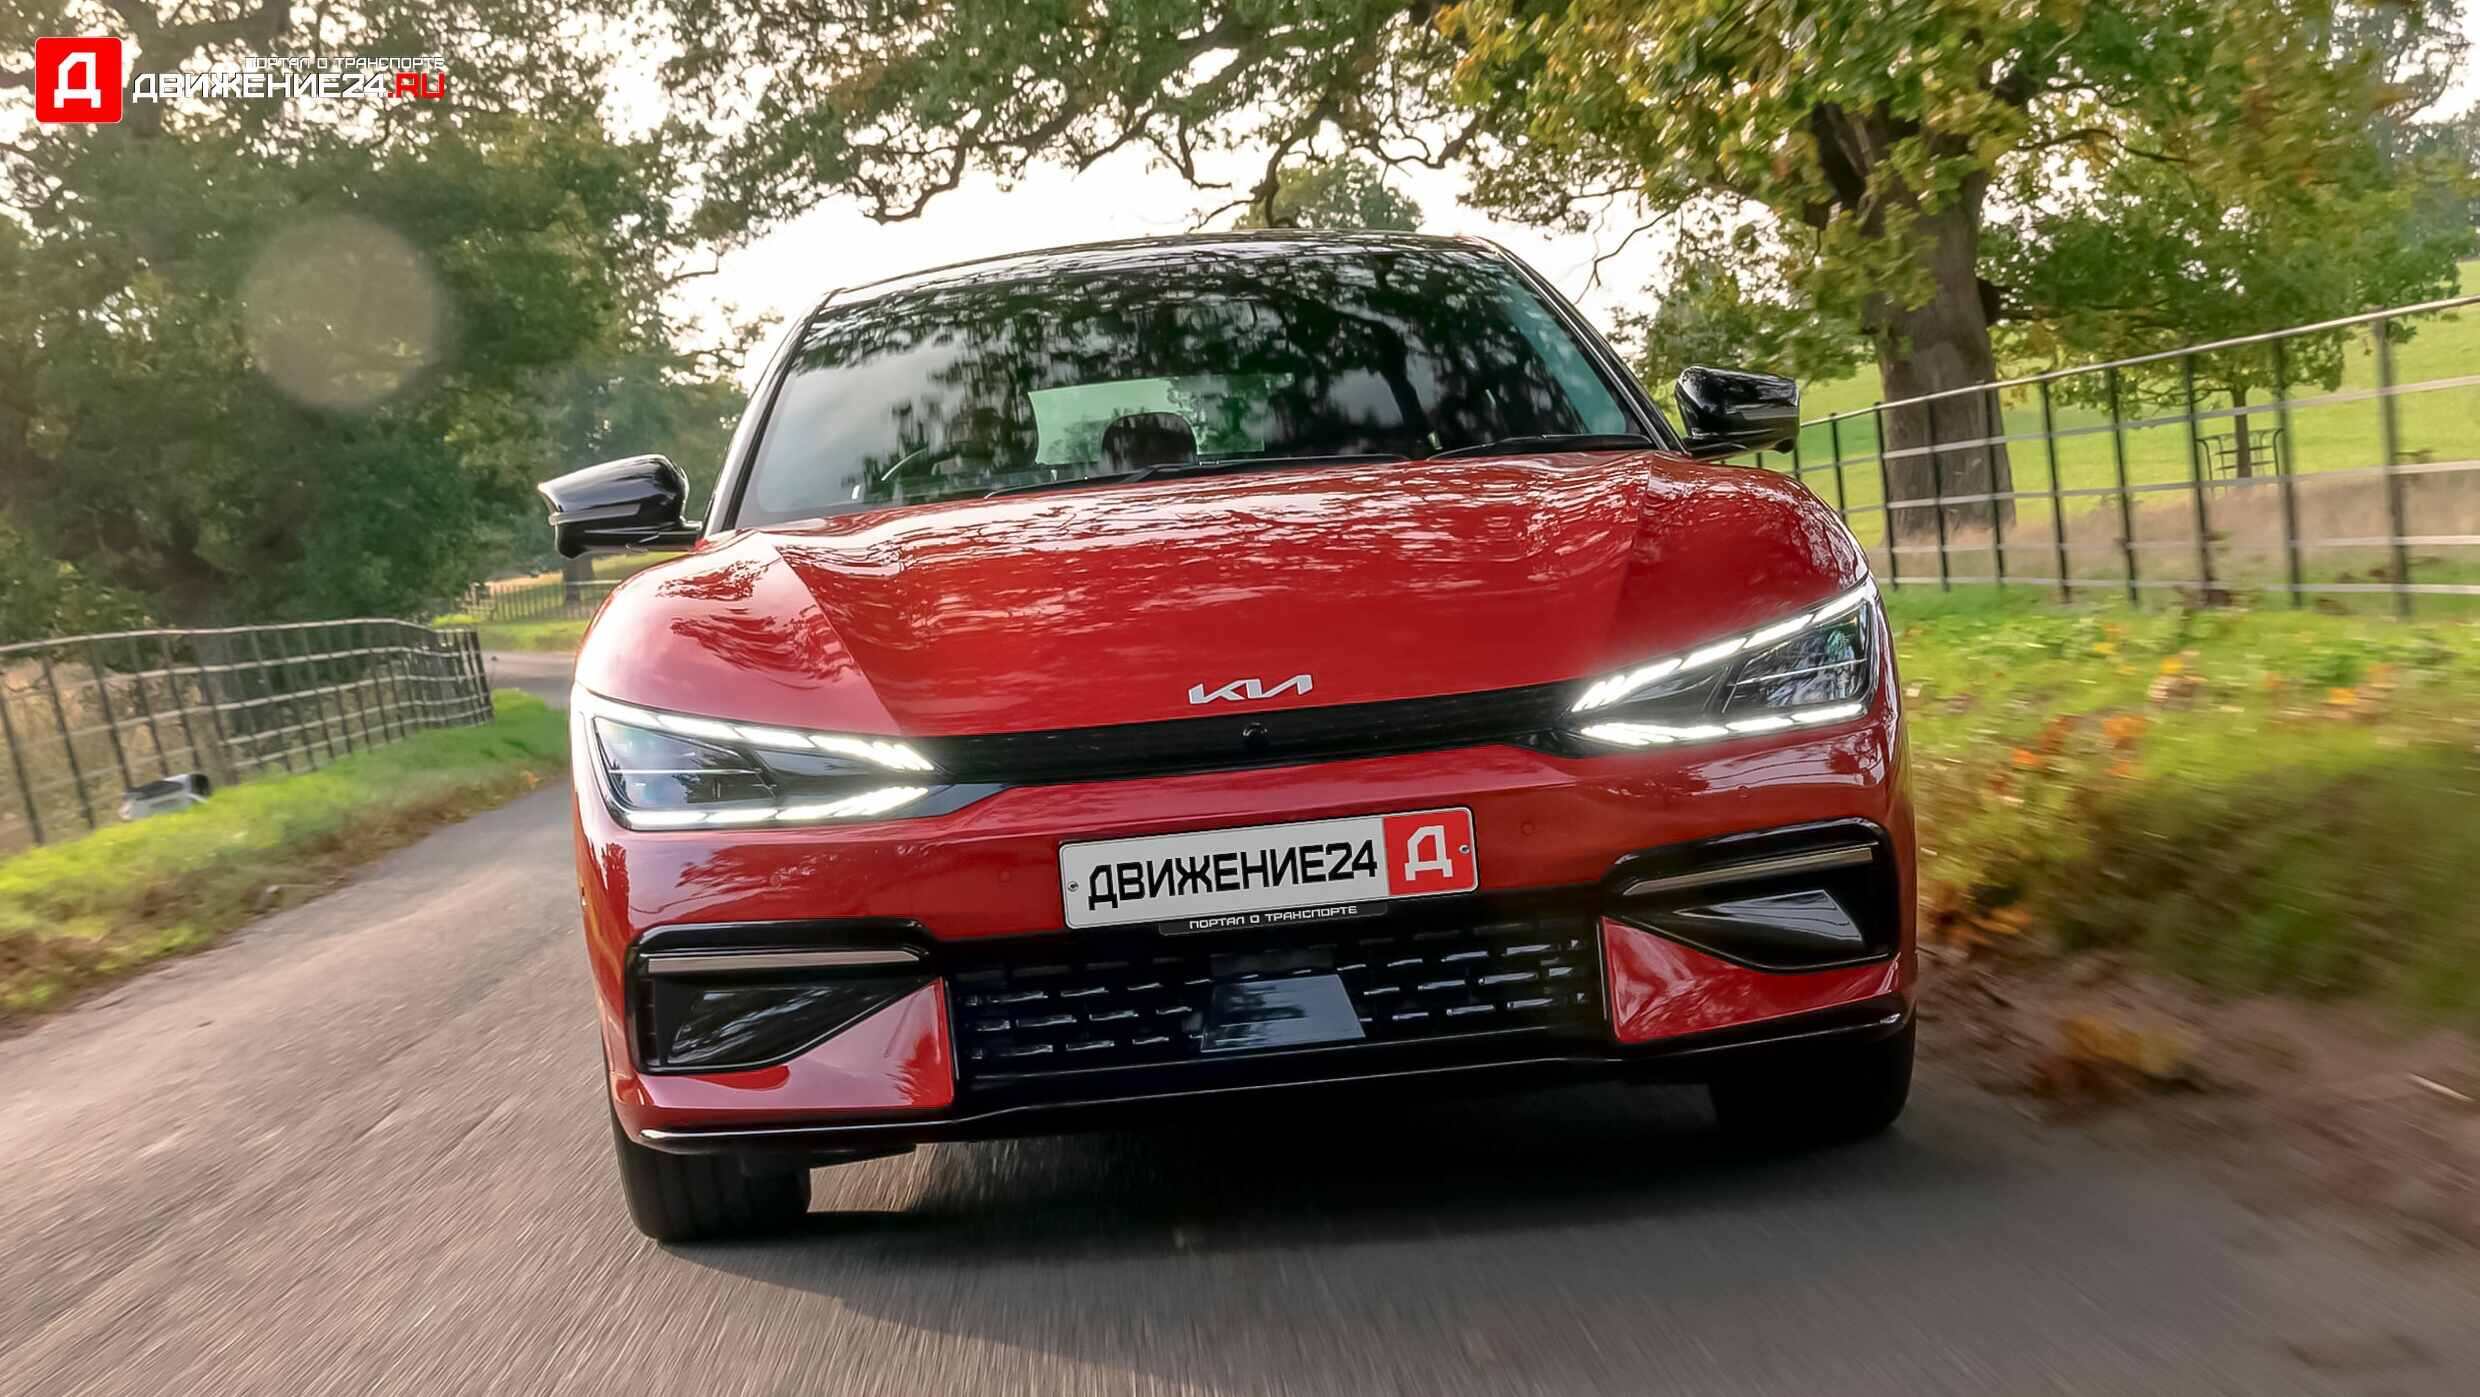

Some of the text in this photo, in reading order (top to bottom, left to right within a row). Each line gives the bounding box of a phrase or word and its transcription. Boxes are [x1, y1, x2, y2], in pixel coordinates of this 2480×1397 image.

[1088, 825, 1453, 910] ДВИЖЕНИЕ24 Д
[1189, 905, 1358, 929] ПОРТАЛ О ТРАНСПОРТЕ
